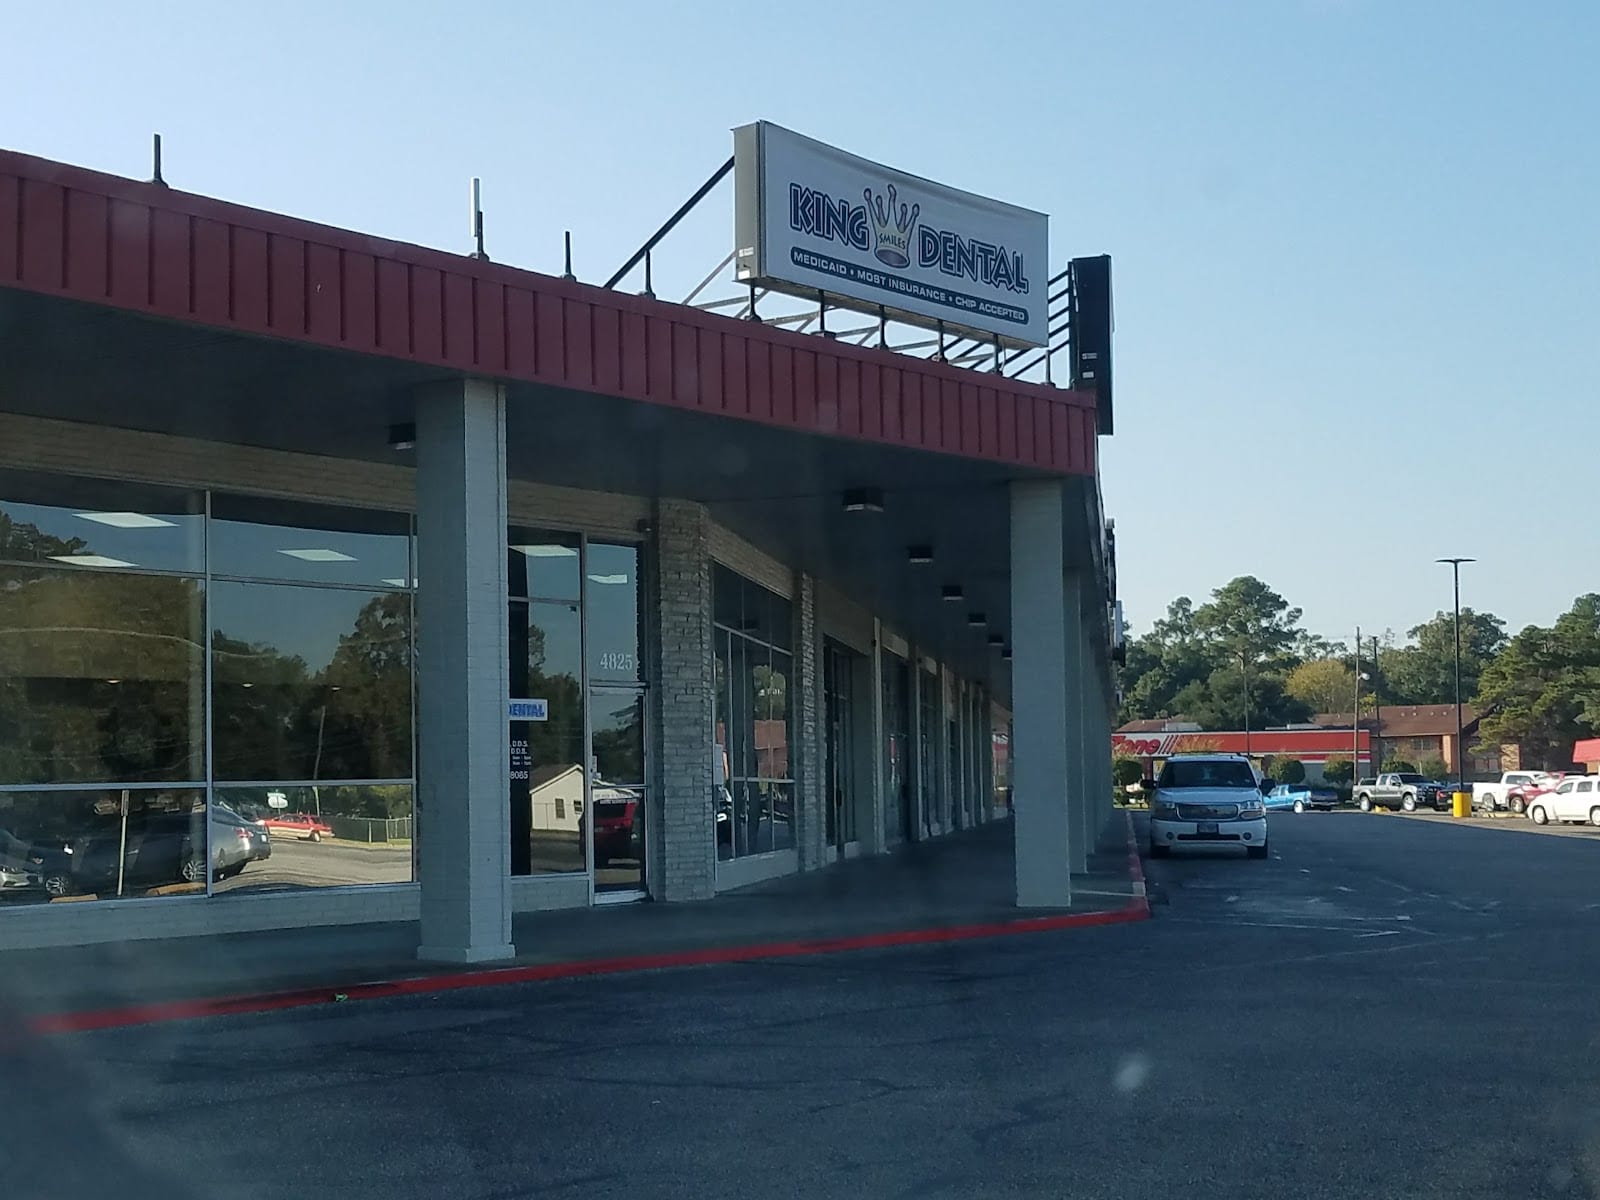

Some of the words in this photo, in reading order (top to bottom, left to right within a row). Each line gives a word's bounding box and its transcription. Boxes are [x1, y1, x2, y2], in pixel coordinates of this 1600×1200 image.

[790, 183, 870, 250] KING
[919, 225, 1028, 294] DENTAL
[879, 232, 906, 249] SMILES
[794, 252, 847, 275] MEDICAID
[857, 270, 886, 285] MOST
[888, 277, 946, 301] INSURANCE
[955, 296, 977, 308] CHIP
[979, 302, 1025, 320] ACCEPTED
[600, 653, 633, 670] 4825
